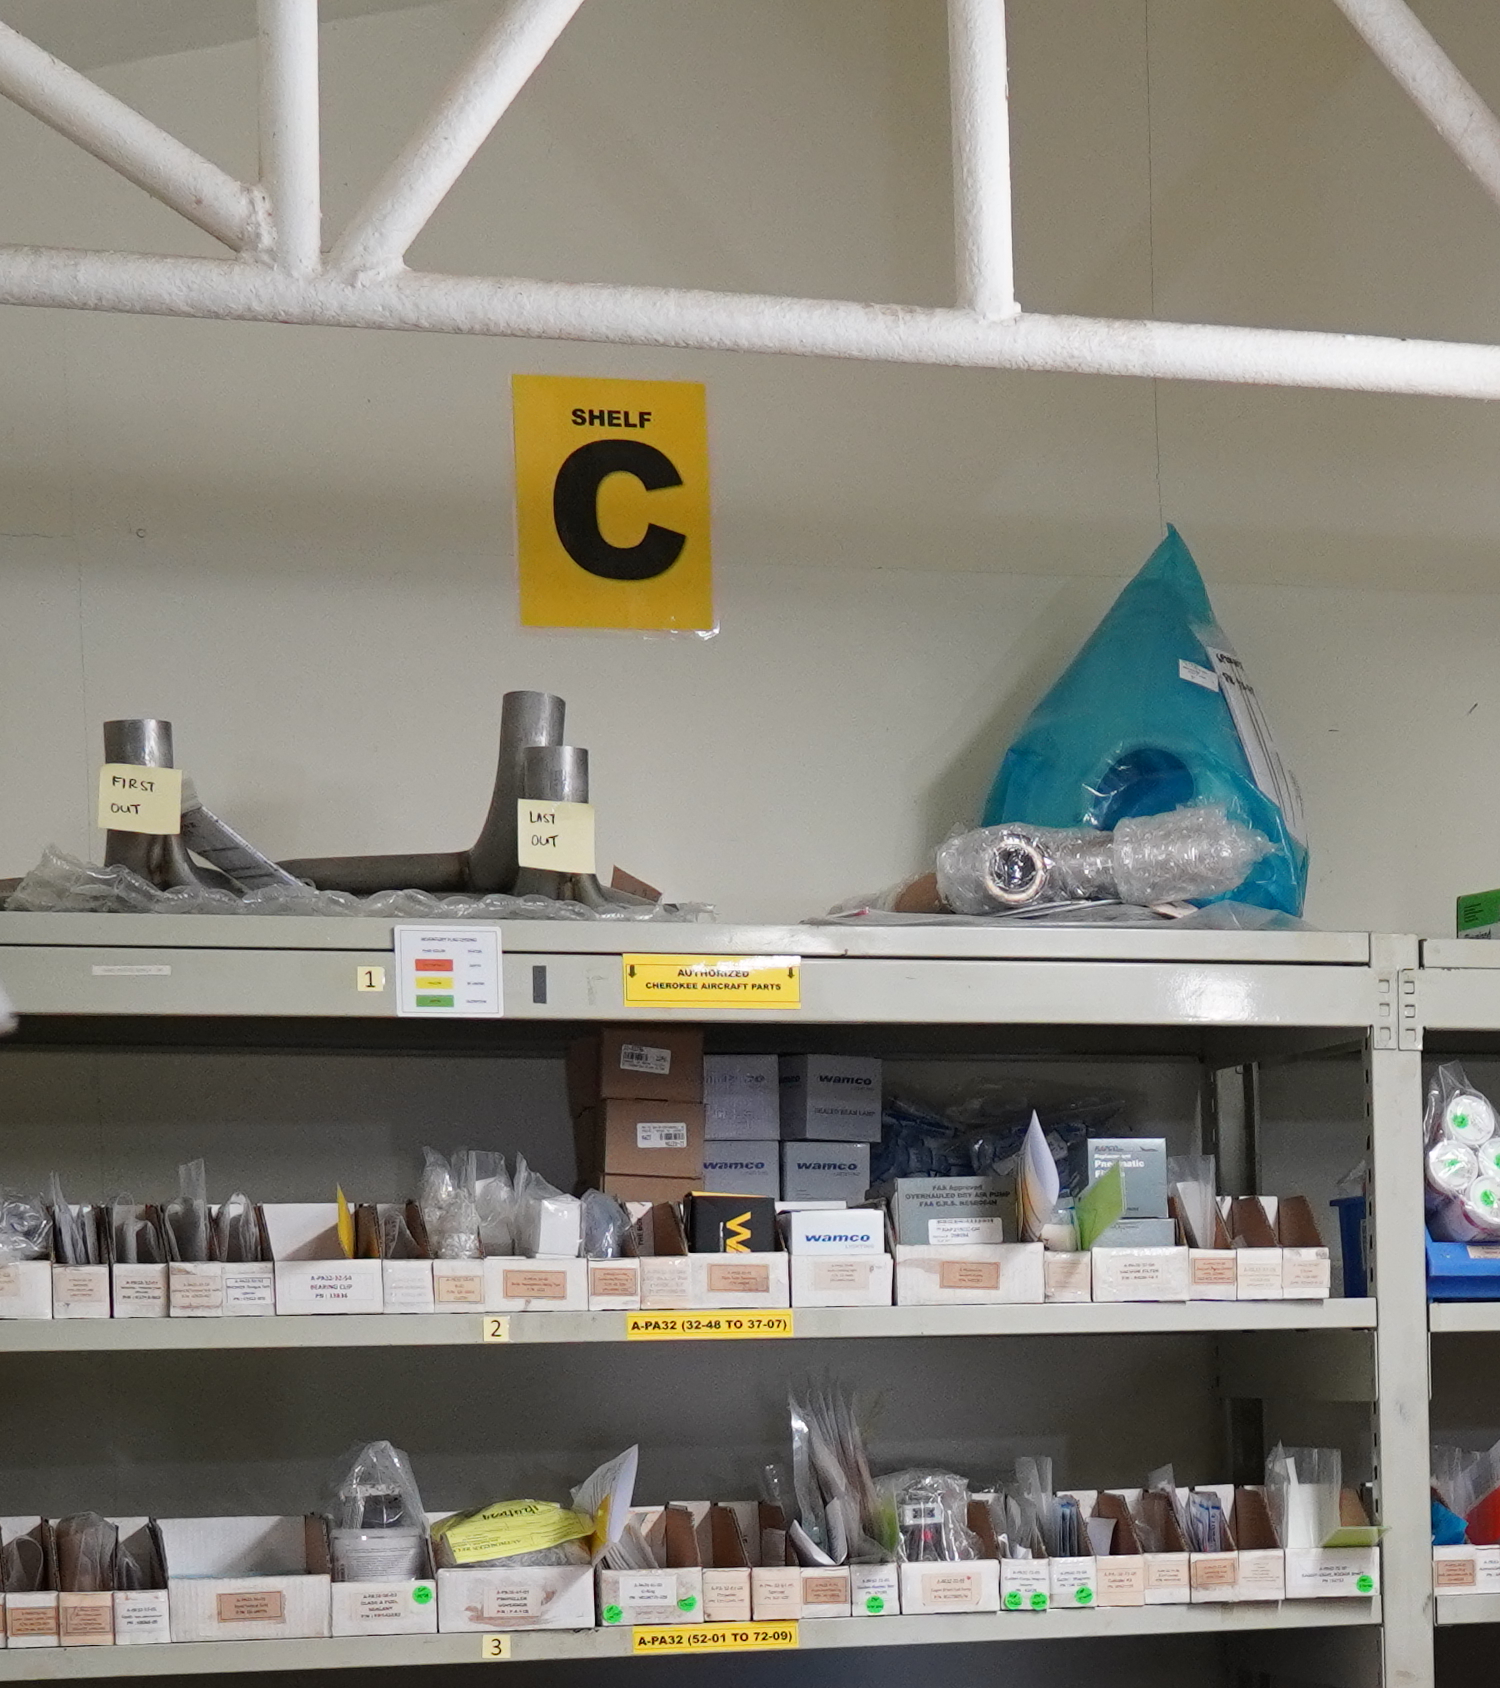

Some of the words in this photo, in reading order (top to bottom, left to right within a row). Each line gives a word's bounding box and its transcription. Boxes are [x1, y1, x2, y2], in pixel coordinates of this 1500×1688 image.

[570, 407, 652, 428] SHELF
[552, 438, 687, 582] C
[111, 775, 156, 794] FIRST
[110, 803, 142, 815] OUT
[529, 810, 555, 825] LAST
[530, 834, 560, 848] OUT
[364, 970, 375, 987] 1
[677, 967, 750, 978] AUTHORIZED
[645, 981, 698, 991] CHEROKEE
[700, 981, 749, 991] AIRCRAFT
[751, 981, 782, 991] PARTS
[819, 1075, 873, 1087] wamco
[703, 1161, 765, 1171] wamco
[796, 1161, 859, 1172] wamco
[949, 1184, 983, 1192] Approved
[804, 1231, 871, 1244] wamco
[489, 1319, 503, 1338] 2
[631, 1320, 678, 1331] A-PA32
[681, 1319, 722, 1333] (32-48
[726, 1319, 743, 1330] TO
[747, 1318, 788, 1332] 37-07)
[638, 1635, 683, 1646] A-PA32
[687, 1633, 727, 1646] (52-01
[731, 1632, 749, 1642] TO
[753, 1631, 793, 1643] 72-09)
[490, 1638, 503, 1656] 3
